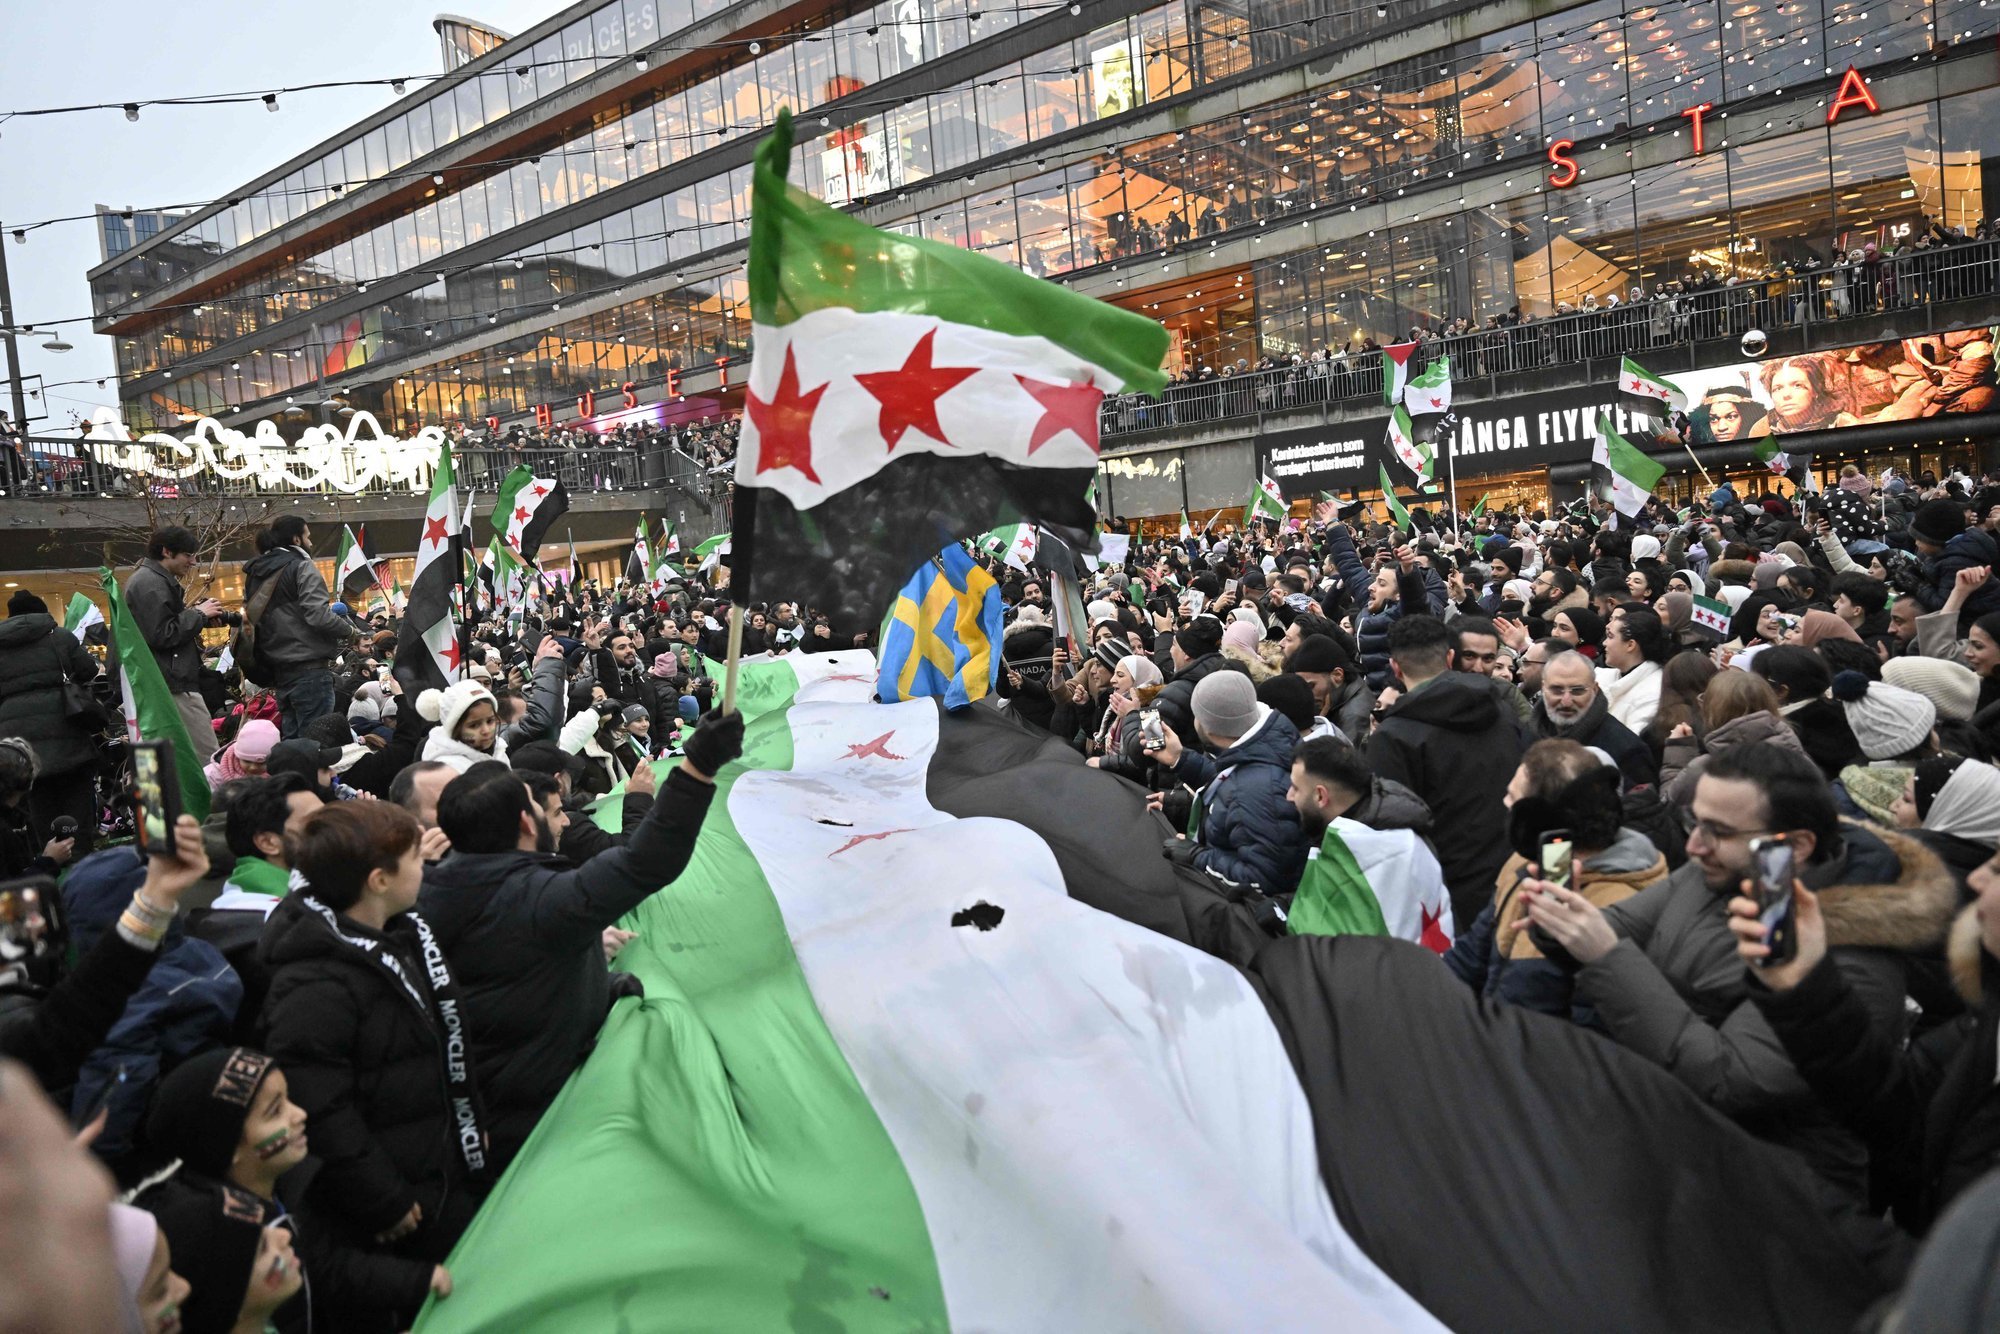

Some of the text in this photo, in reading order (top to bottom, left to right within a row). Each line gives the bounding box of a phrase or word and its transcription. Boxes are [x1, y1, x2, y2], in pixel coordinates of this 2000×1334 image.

[1343, 439, 1364, 453] som
[1449, 402, 1649, 457] LÅNGA FLYKTEN
[406, 912, 450, 991] MONCLER
[439, 999, 466, 1084] MONCLER
[453, 1097, 485, 1172] MONCLER
